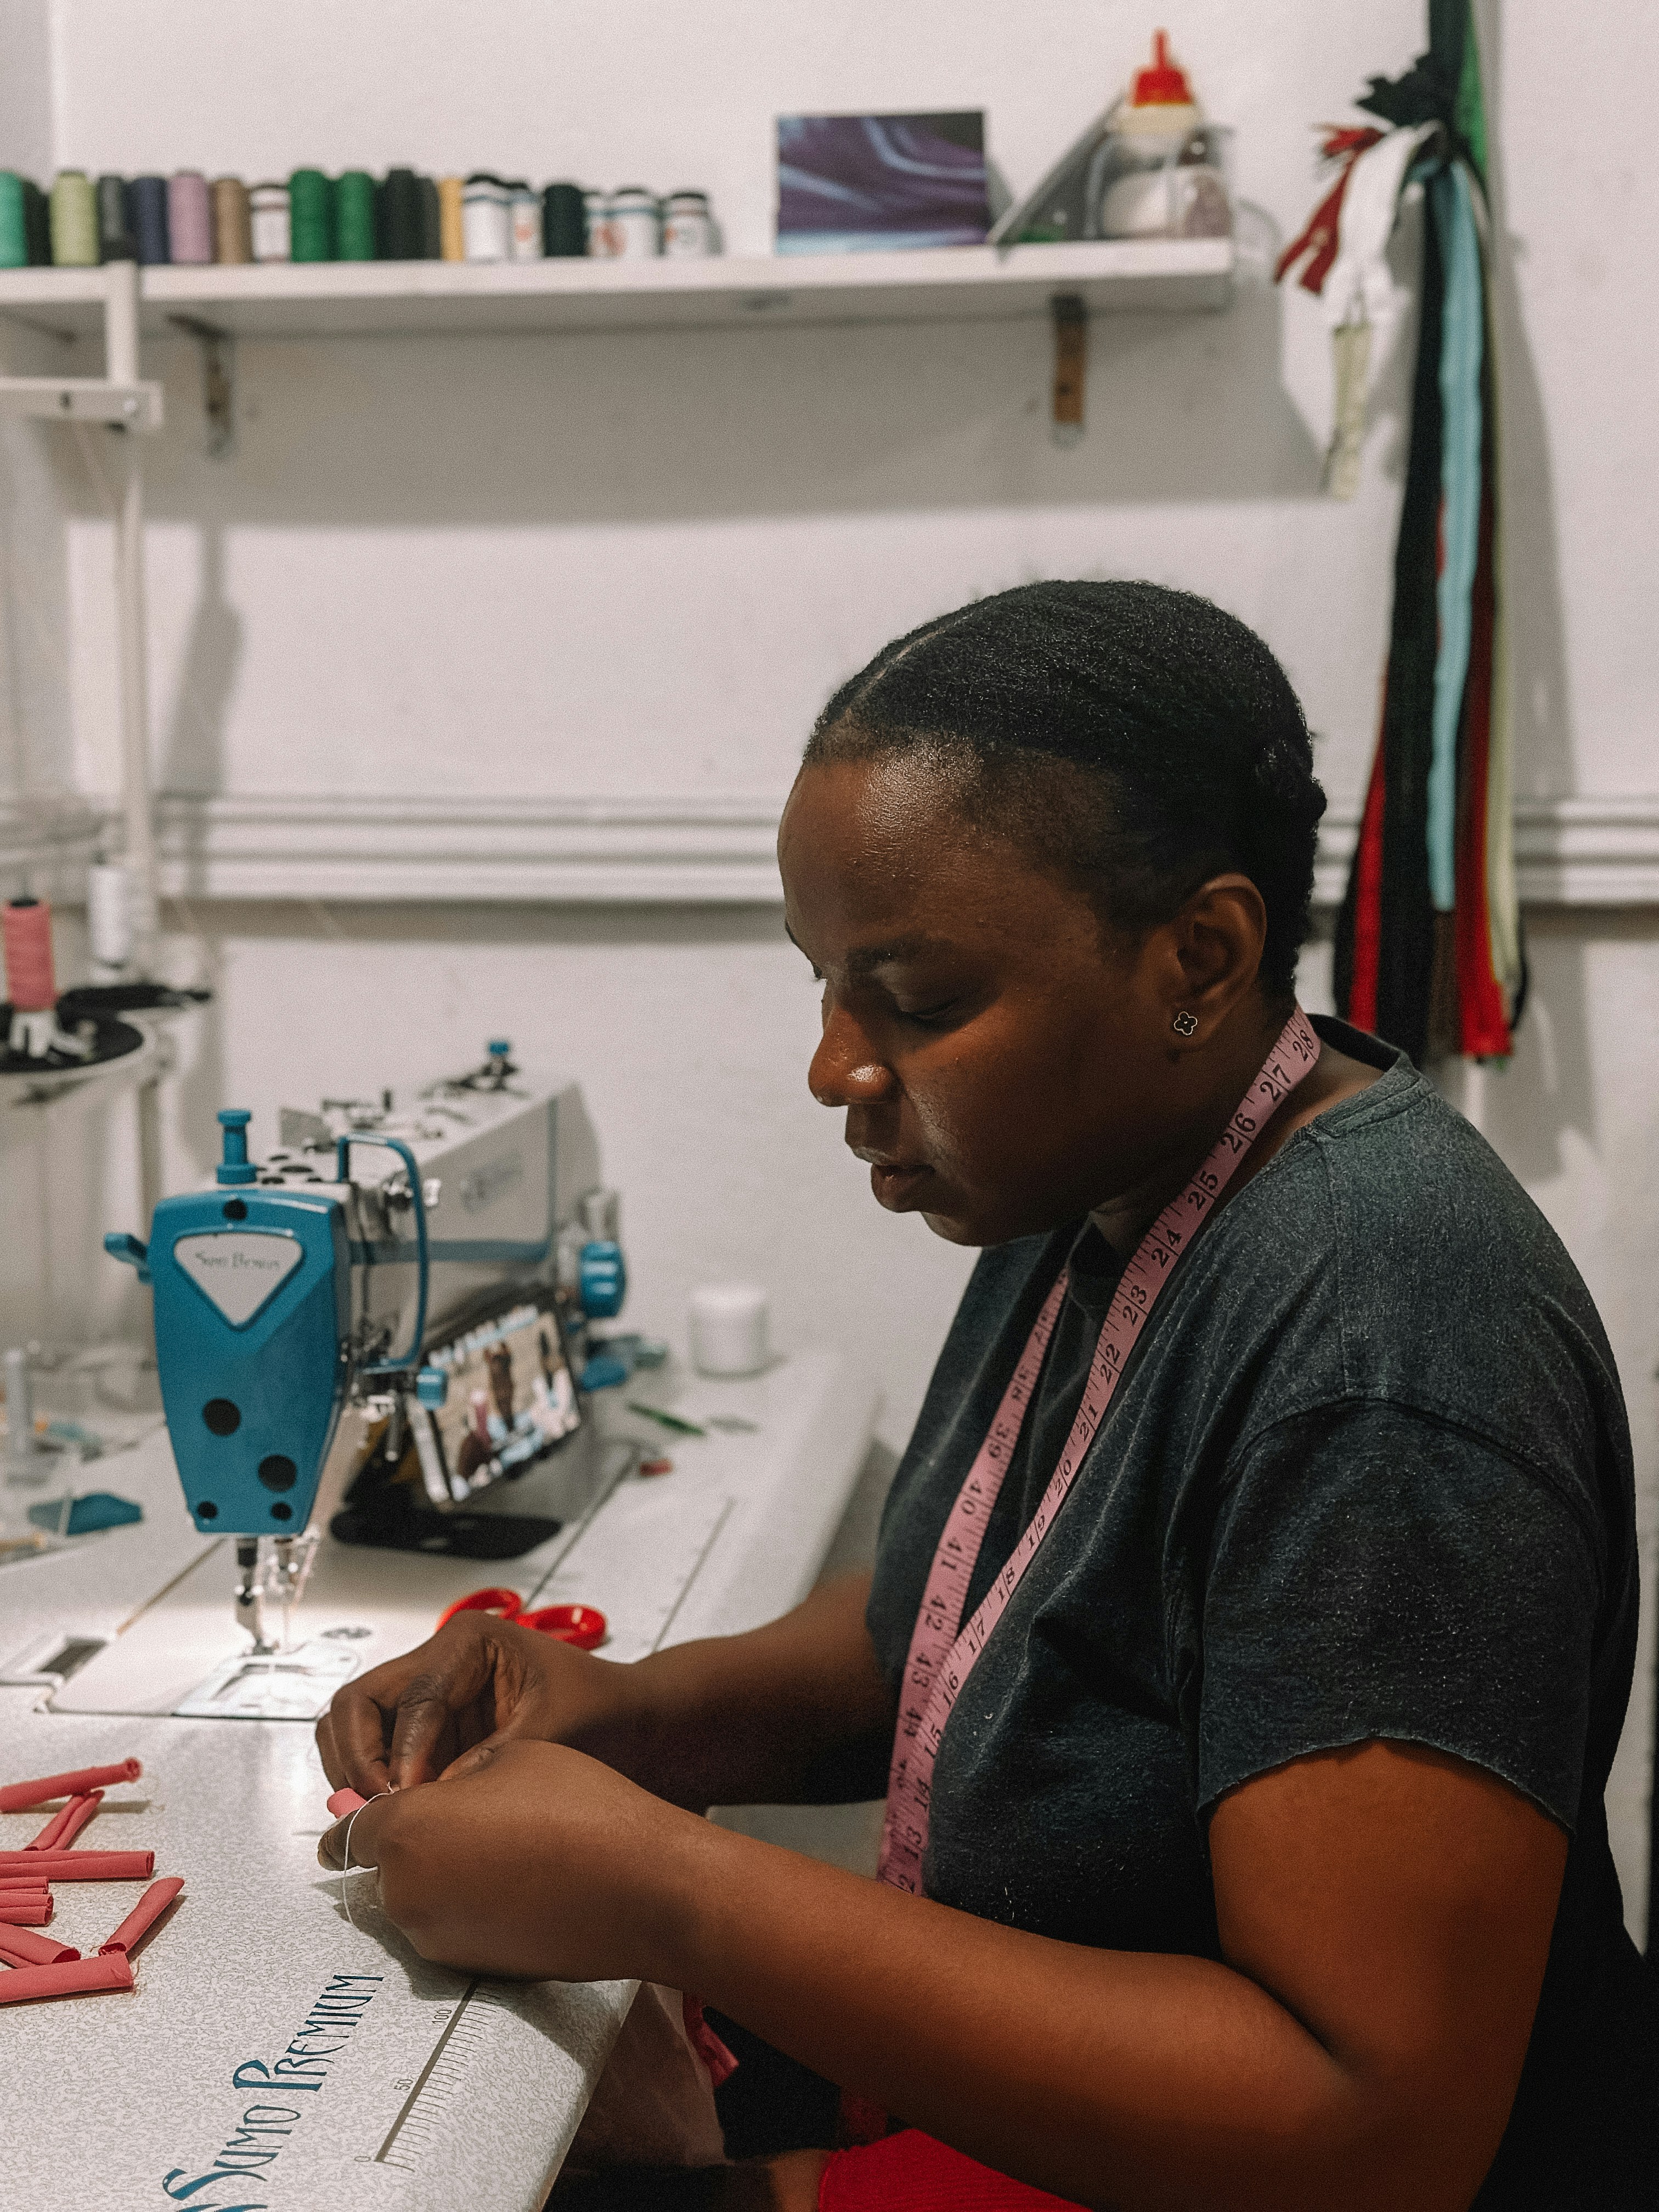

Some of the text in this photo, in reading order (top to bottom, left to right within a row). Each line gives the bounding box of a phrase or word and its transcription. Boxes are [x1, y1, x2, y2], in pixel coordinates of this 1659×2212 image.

[943, 1671, 958, 1709] 16
[968, 1618, 985, 1655] 17
[998, 1567, 1015, 1604] 18
[1055, 1459, 1071, 1497] 20
[1080, 1404, 1098, 1442] 21
[1100, 1344, 1120, 1385] 22
[1122, 1285, 1147, 1327] 23
[1152, 1229, 1182, 1268] 24
[1188, 1171, 1218, 1211] 25
[1221, 1113, 1256, 1153] 26
[1260, 1064, 1291, 1102] 27
[1293, 1029, 1314, 1062] 28
[962, 1480, 982, 1515] 40
[941, 1537, 962, 1570] 41
[924, 1595, 946, 1630] 42
[912, 1652, 933, 1688] 43
[394, 2078, 413, 2091] 50
[432, 2008, 453, 2024] 100
